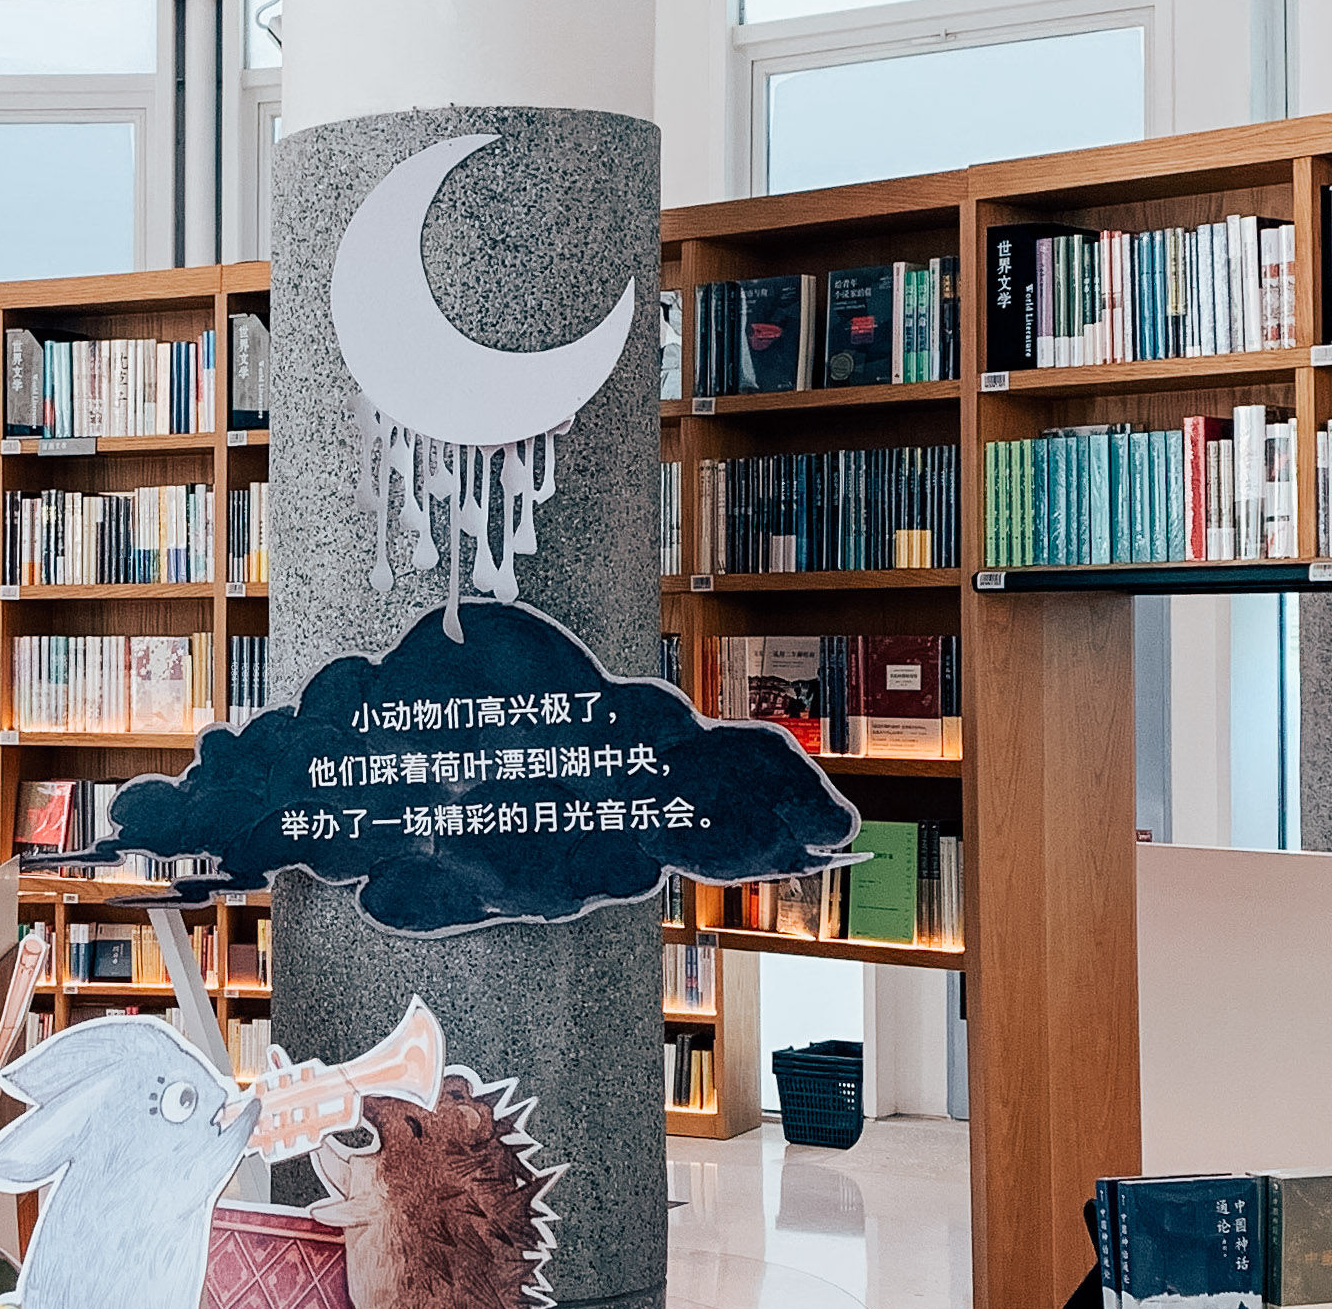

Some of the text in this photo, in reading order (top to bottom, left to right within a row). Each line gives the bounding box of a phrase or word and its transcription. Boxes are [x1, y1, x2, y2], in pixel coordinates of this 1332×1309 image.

[997, 240, 1012, 309] 世界文学
[1025, 284, 1034, 357] World Literature
[352, 692, 620, 733] 小动物们高兴极了，
[308, 741, 673, 789] 他们踩着荷叶漂到湖中央，
[280, 796, 714, 842] 举办了一场精彩的月光音乐会。
[1216, 1199, 1231, 1234] 通论
